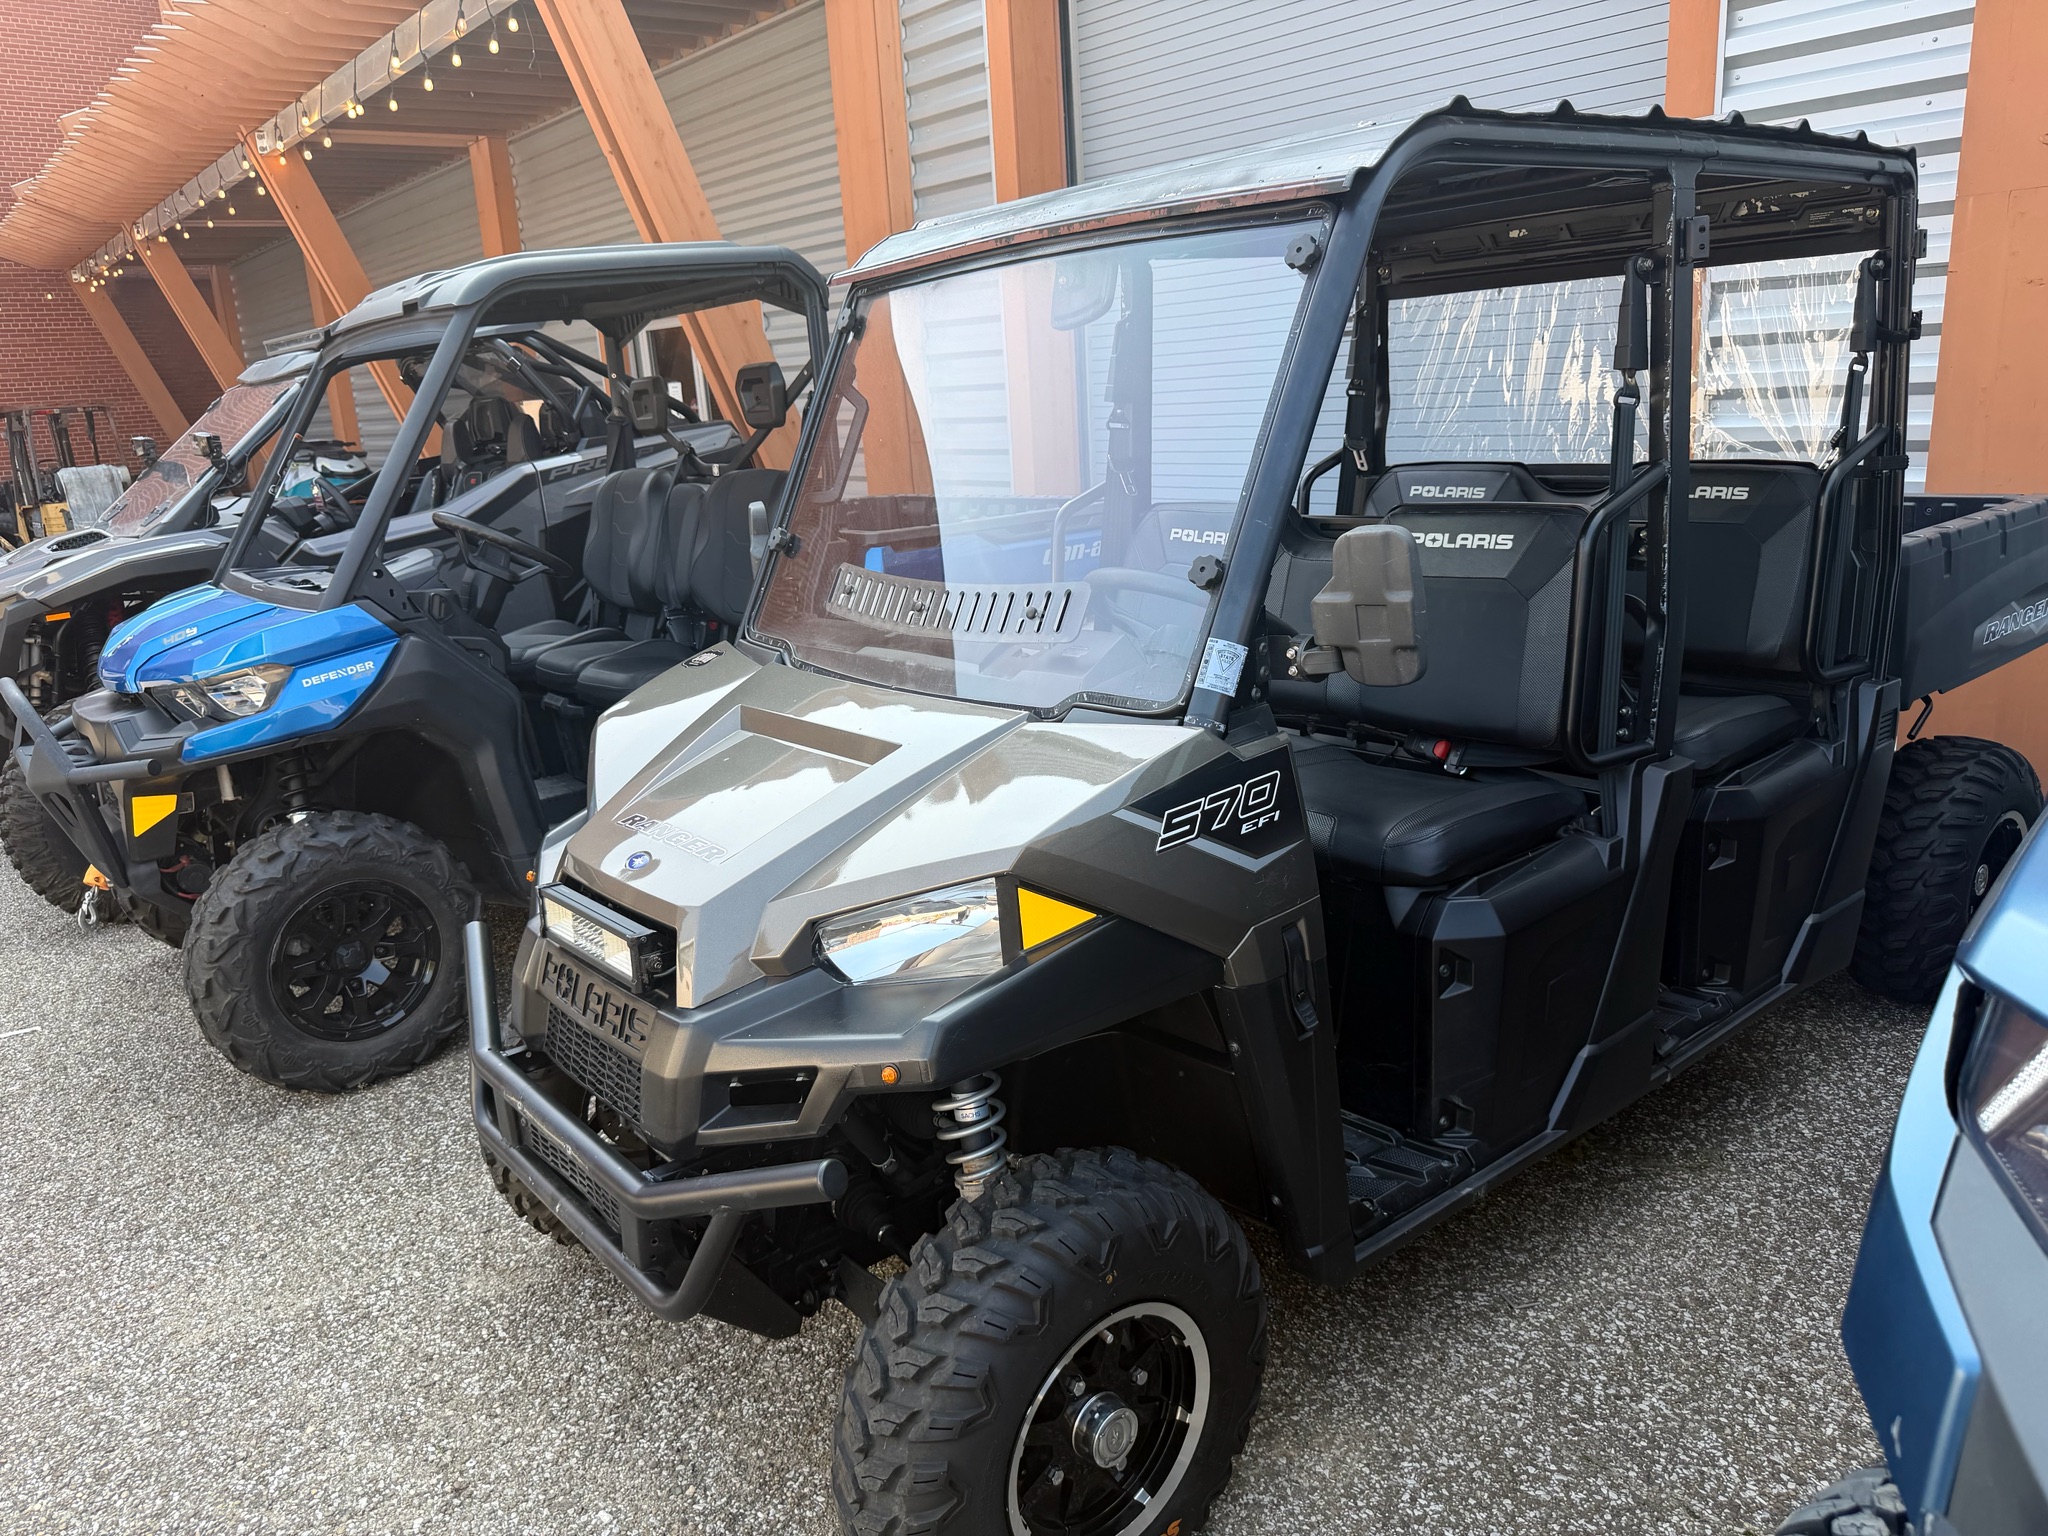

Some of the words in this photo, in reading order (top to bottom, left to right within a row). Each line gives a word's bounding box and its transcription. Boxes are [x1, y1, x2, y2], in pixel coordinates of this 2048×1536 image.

[1409, 486, 1486, 499] POLARIS
[1688, 485, 1750, 500] ARIS
[1170, 528, 1229, 545] POLARI
[302, 661, 375, 688] DEFENDER
[1156, 770, 1280, 852] 570
[1241, 810, 1280, 835] EFI
[616, 813, 728, 863] RANGER
[541, 951, 651, 1054] POLARIS
[961, 1110, 981, 1119] SACHS
